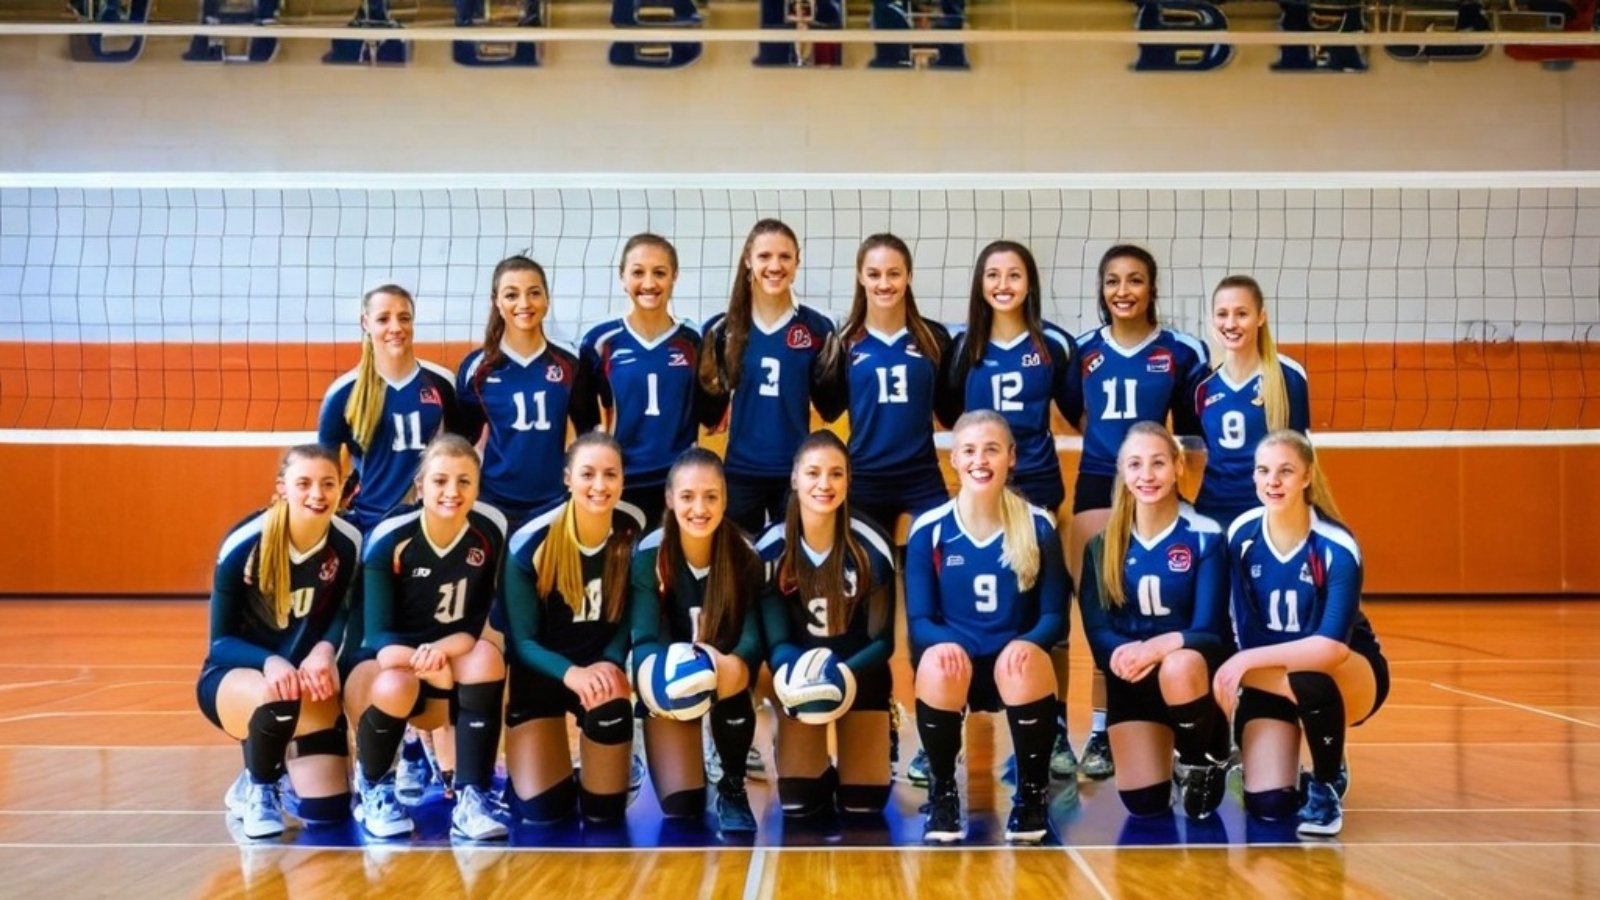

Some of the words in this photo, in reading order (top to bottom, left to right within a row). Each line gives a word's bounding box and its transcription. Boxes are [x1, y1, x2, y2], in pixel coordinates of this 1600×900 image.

[644, 373, 660, 416] 1
[876, 364, 909, 404] 13
[991, 371, 1024, 411] 12
[1101, 377, 1138, 420] 11
[511, 390, 551, 431] 11
[392, 411, 426, 452] 11
[973, 574, 998, 613] 9
[1267, 589, 1301, 633] 11
